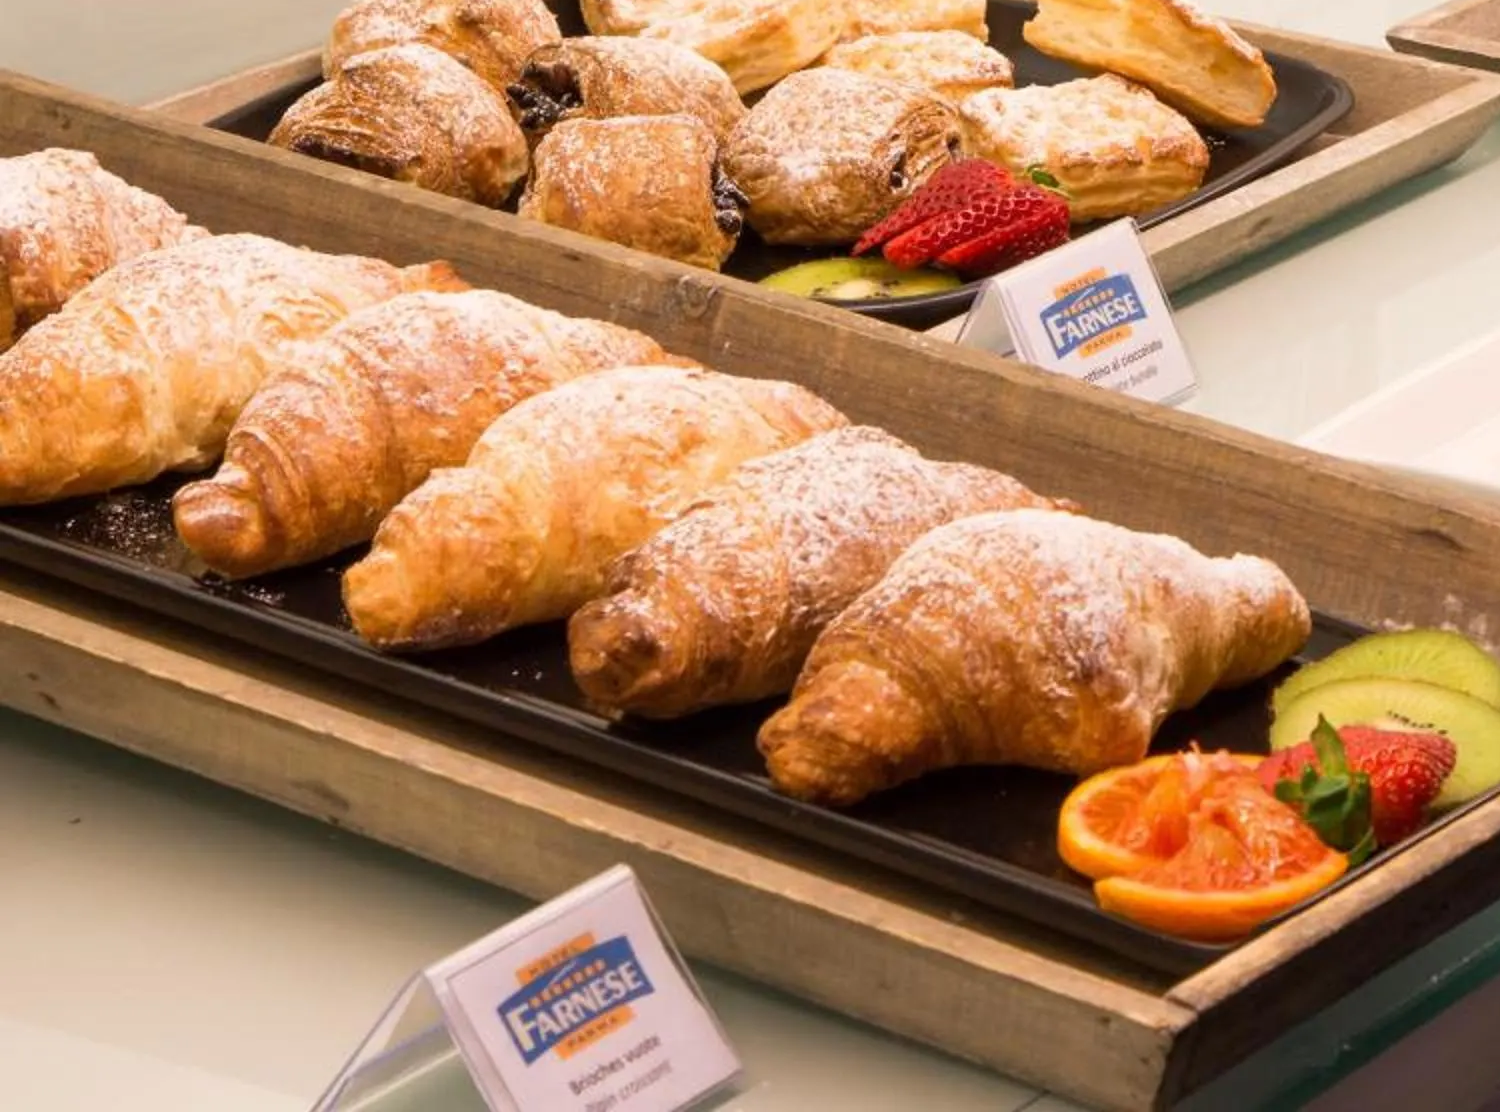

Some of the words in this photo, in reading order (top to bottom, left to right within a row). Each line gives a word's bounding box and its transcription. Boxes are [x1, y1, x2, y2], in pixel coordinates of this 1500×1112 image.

[1045, 292, 1141, 351] FARNESE
[505, 961, 645, 1053] FARNESE
[569, 1058, 625, 1096] Brioches
